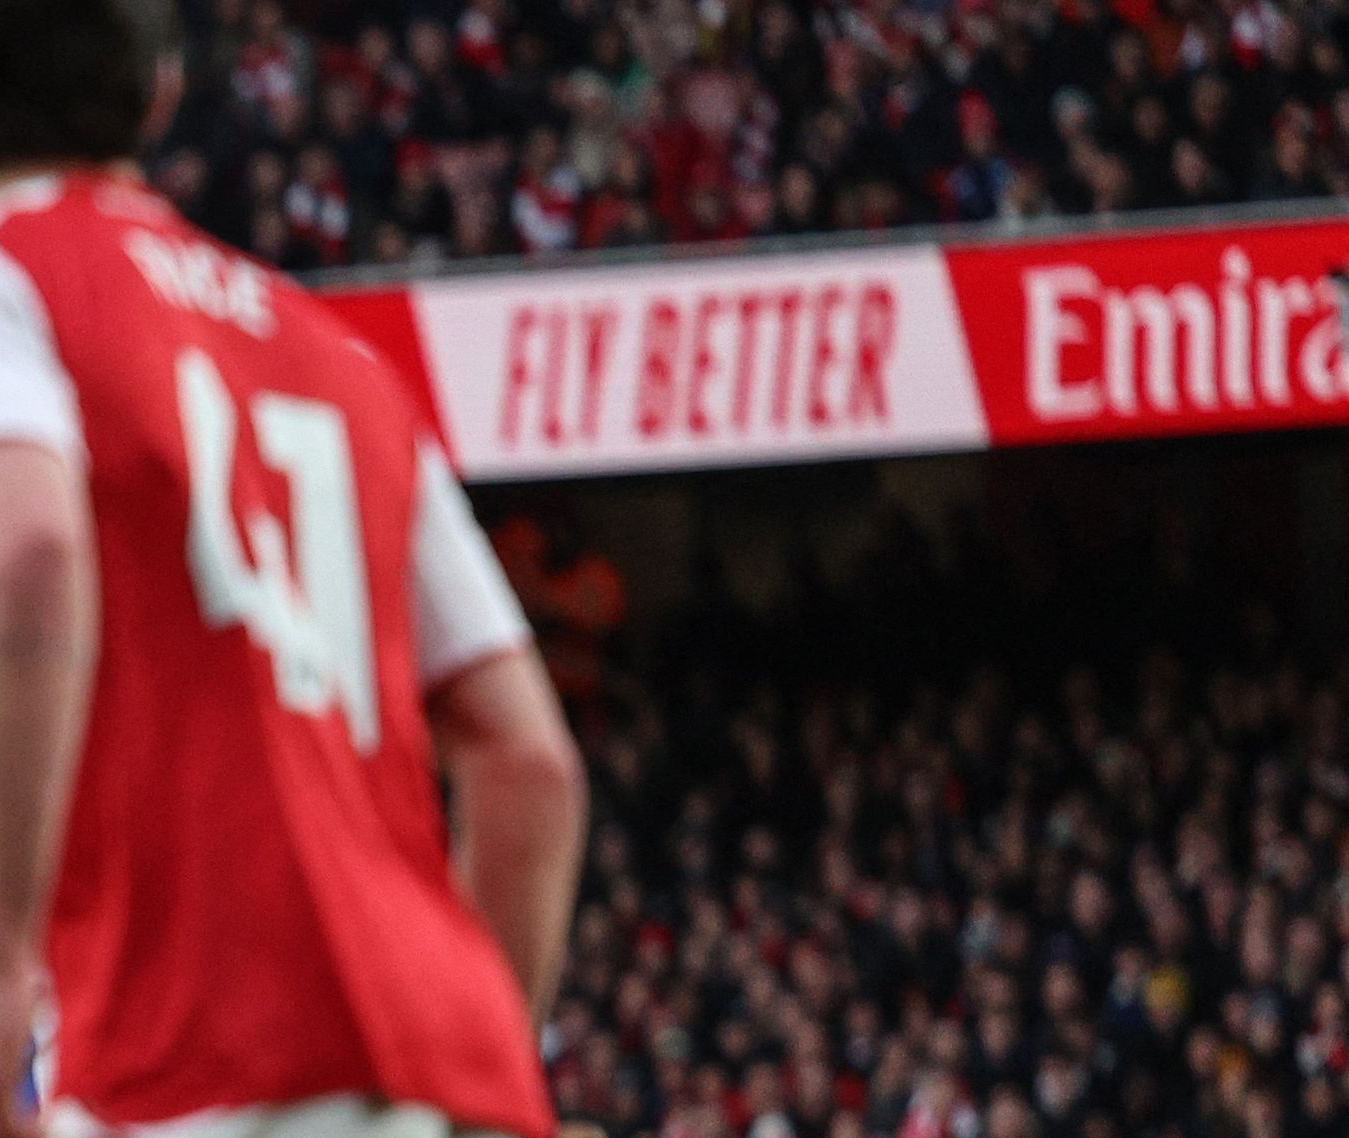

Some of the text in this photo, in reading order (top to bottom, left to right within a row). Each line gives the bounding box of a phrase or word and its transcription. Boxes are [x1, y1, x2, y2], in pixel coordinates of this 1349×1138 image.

[498, 280, 896, 448] FLY BETTER
[175, 347, 381, 757] 41
